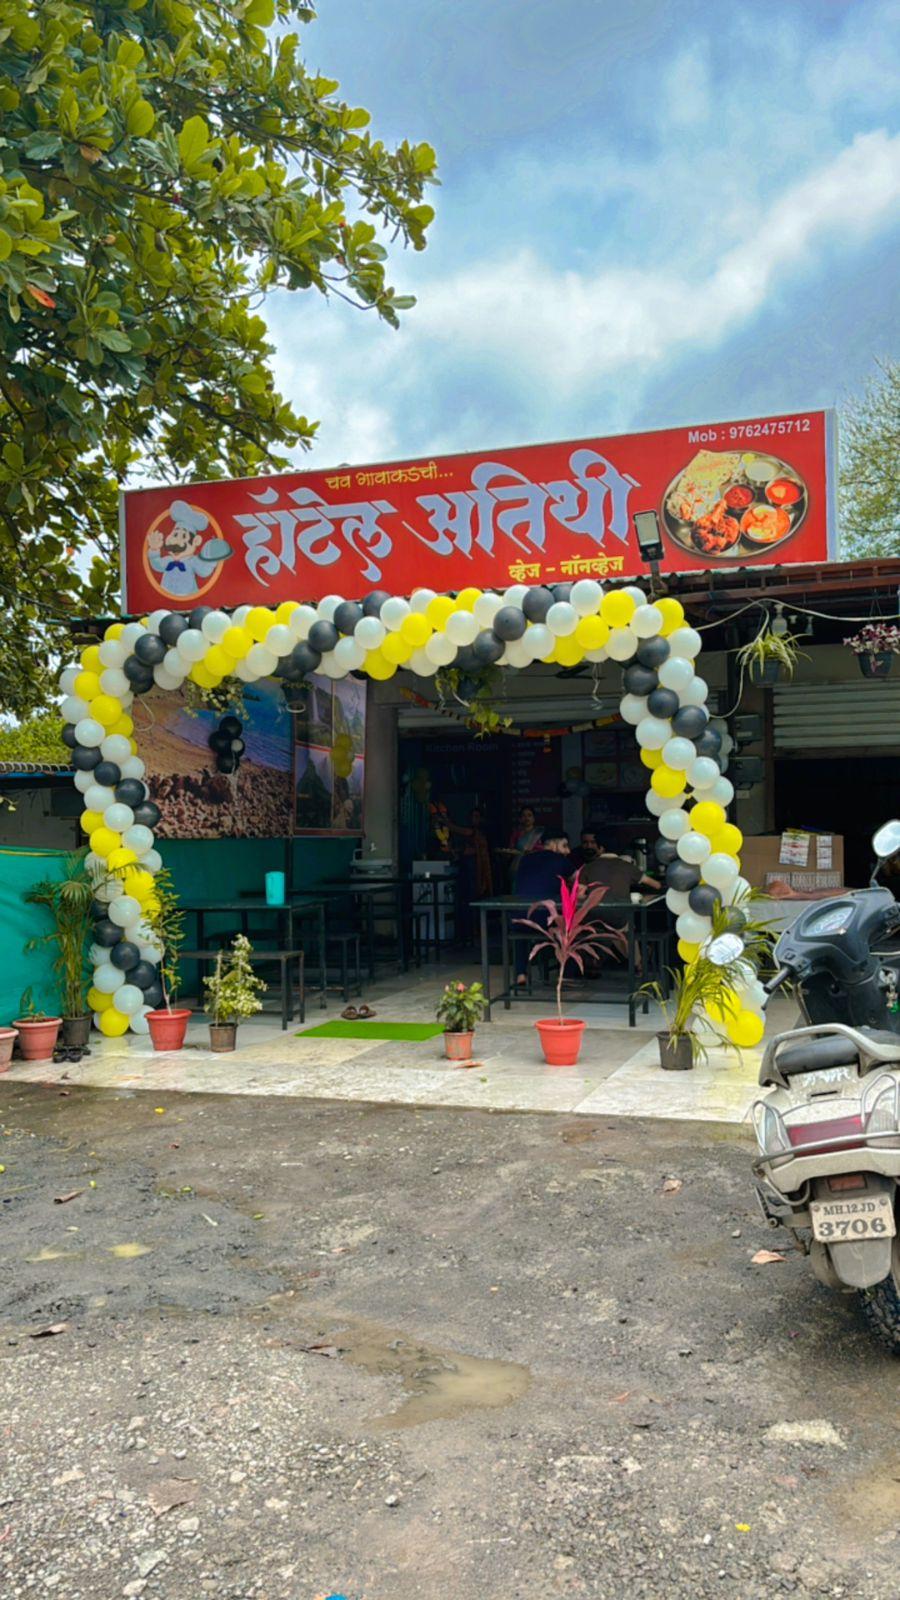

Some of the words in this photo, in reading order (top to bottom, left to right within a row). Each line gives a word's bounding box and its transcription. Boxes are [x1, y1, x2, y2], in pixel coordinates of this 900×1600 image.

[688, 429, 717, 443] Mob
[730, 419, 810, 439] 9762475712
[325, 474, 352, 490] चव
[232, 486, 398, 587] हॉटेल
[402, 448, 642, 560] अतिथी
[508, 559, 541, 582] व्हेज
[560, 552, 625, 576] नॉनव्हेज
[819, 1217, 886, 1237] 3706
